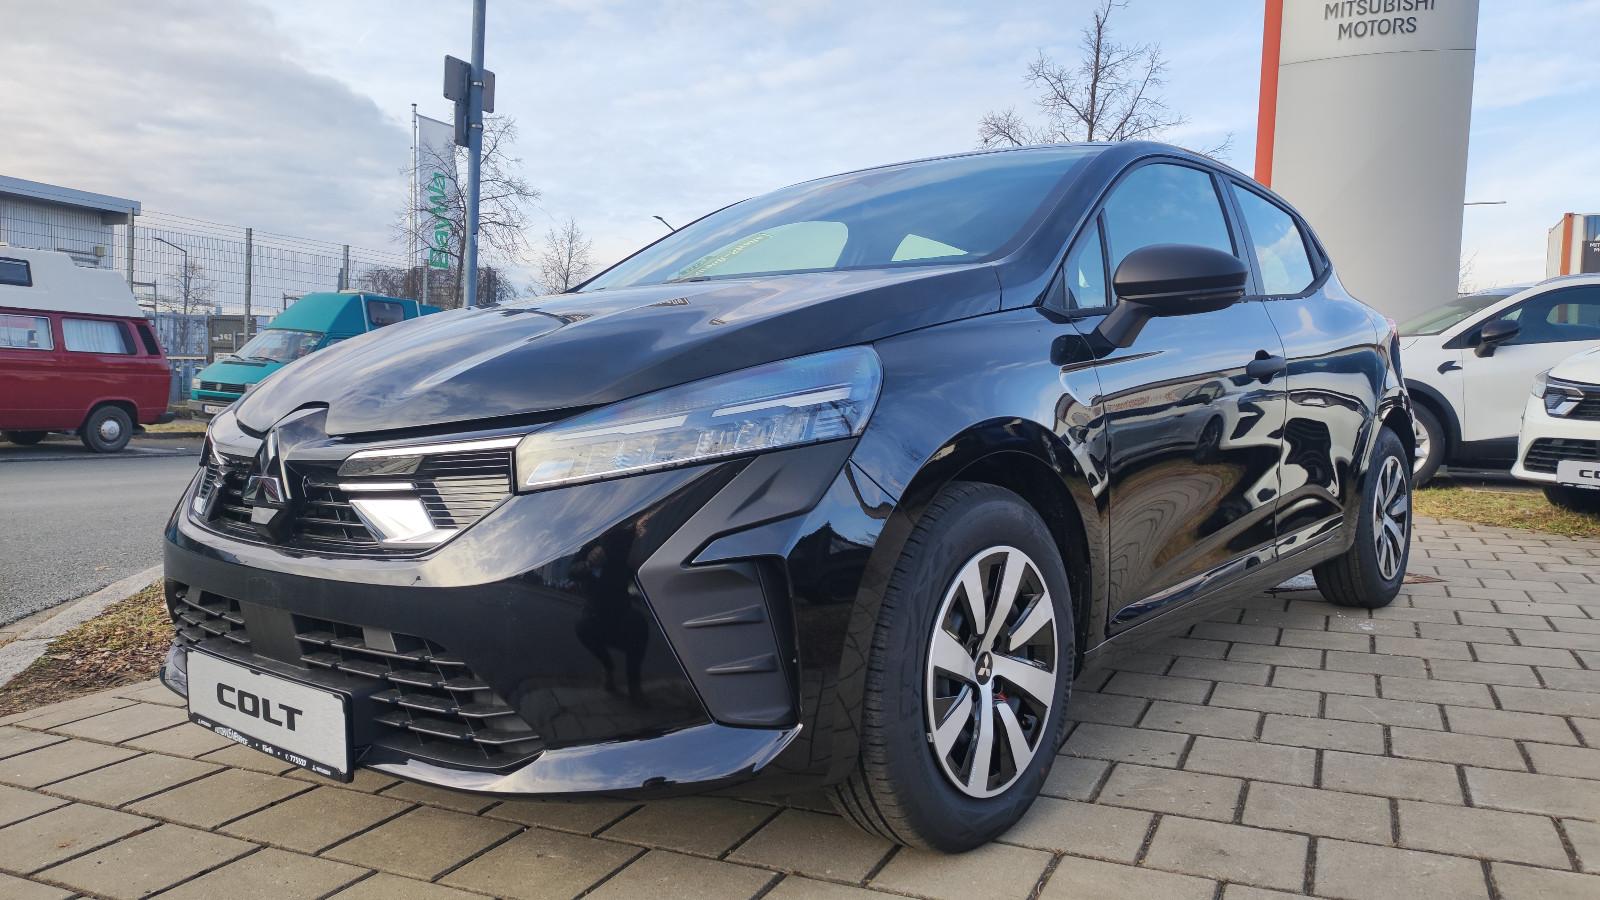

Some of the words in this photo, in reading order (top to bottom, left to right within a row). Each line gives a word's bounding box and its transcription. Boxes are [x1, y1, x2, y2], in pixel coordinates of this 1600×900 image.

[1324, 0, 1435, 20] MITSUBISHI
[1337, 16, 1417, 41] MOTORS
[427, 171, 453, 269] BayWa
[216, 682, 303, 732] COLT
